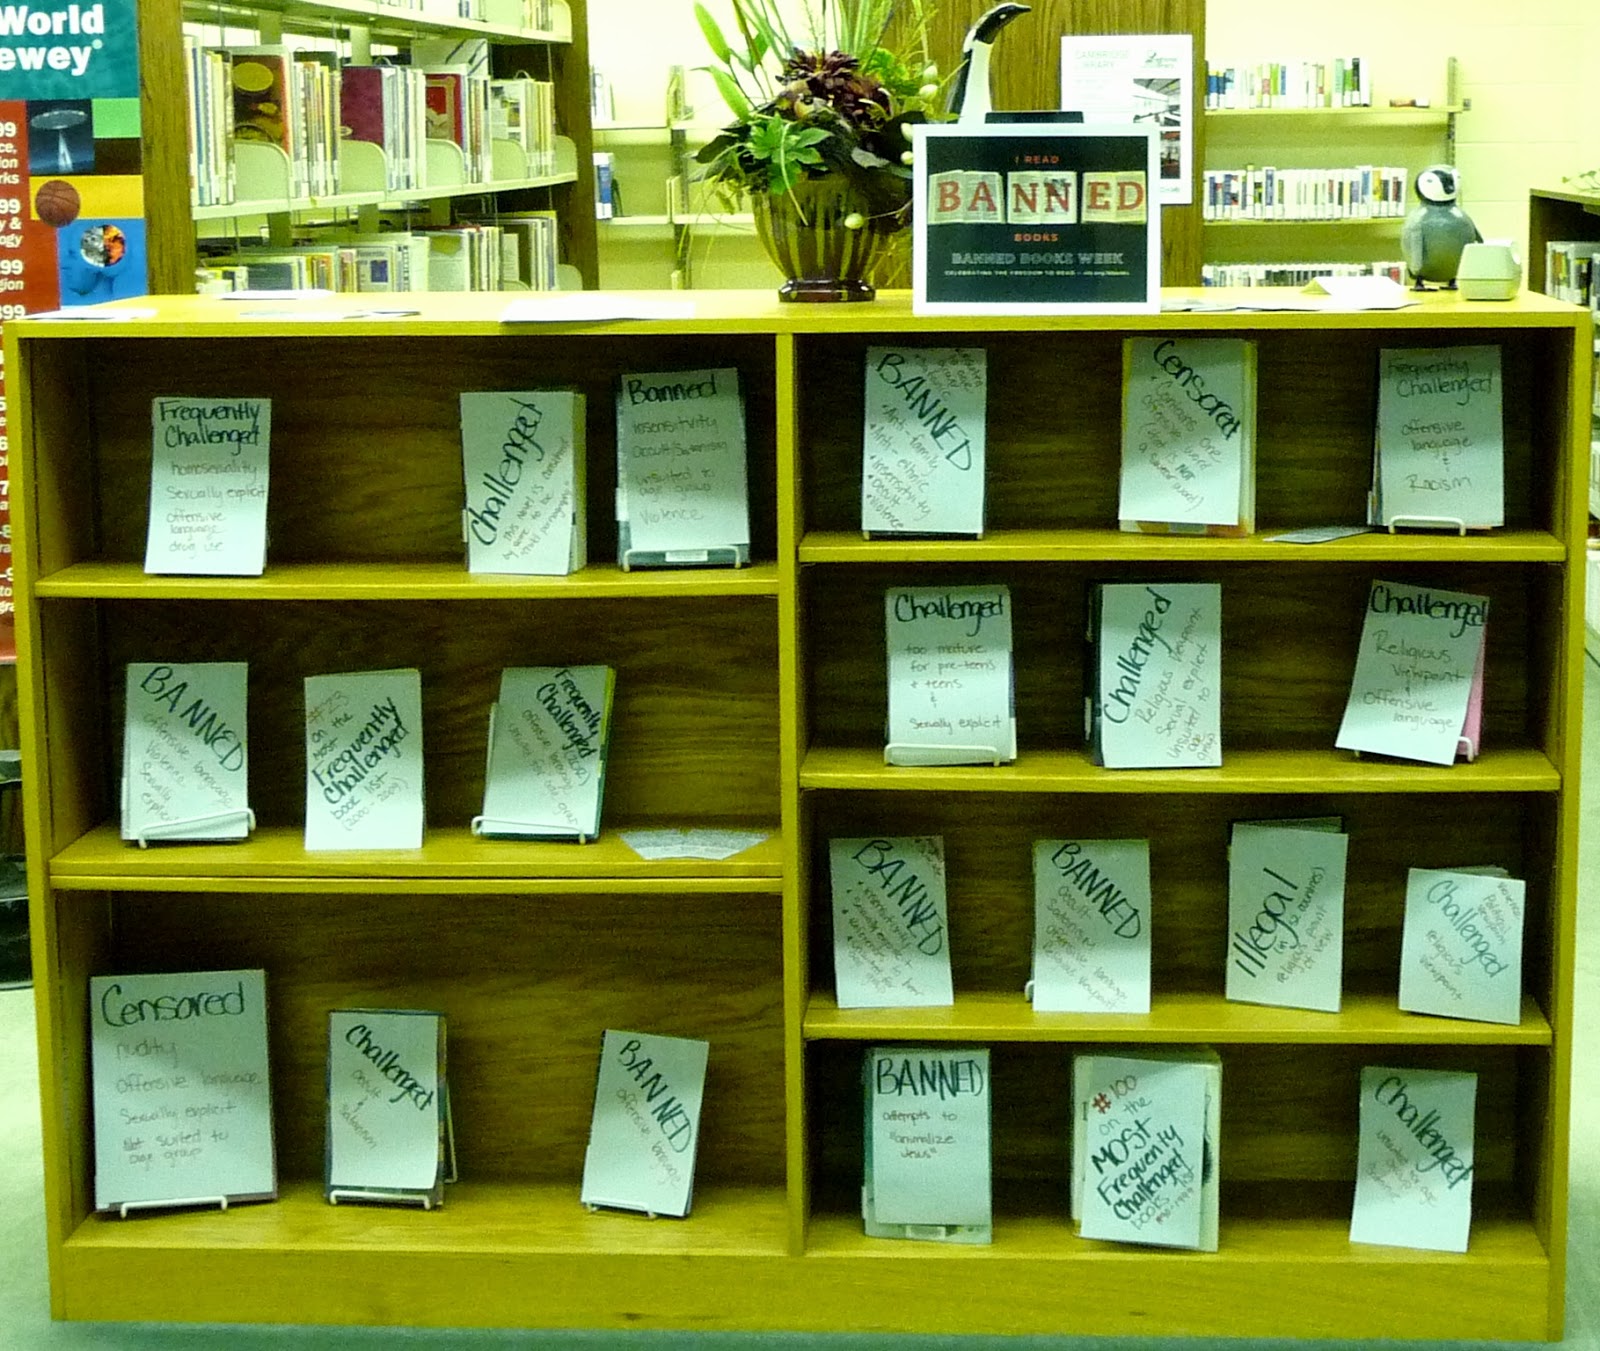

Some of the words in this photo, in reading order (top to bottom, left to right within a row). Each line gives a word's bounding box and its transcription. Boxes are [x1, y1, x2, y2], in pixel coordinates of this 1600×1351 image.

[0, 5, 104, 35] World
[1024, 156, 1060, 164] READ
[937, 180, 1146, 214] BANNED
[951, 253, 1016, 264] BANNED
[1020, 253, 1074, 264] BOOKS
[1078, 253, 1125, 264] WEEK
[1013, 233, 1059, 242] BOOKS
[627, 373, 718, 406] Banned
[1153, 340, 1241, 440] Censored
[1388, 357, 1470, 381] Frequently
[1396, 373, 1493, 406] Challenged
[159, 400, 261, 430] Frequently
[876, 353, 971, 471] BANNED
[165, 424, 260, 456] Challenged
[467, 397, 545, 546] Challenged
[1405, 473, 1472, 493] Racism
[895, 594, 1003, 637] Challenged
[1371, 585, 1486, 638] Challenged
[1103, 586, 1172, 724] Challenged
[1372, 629, 1452, 668] Religious
[140, 666, 244, 772] BANNED
[536, 682, 598, 759] Challenged
[554, 669, 602, 739] Frequently
[1393, 713, 1456, 733] language
[311, 696, 402, 787] Frequently
[323, 725, 411, 804] Challenged
[851, 839, 944, 956] BANNED
[1051, 842, 1141, 938] BANNED
[1427, 880, 1510, 978] Challenged
[101, 981, 244, 1027] Censored
[345, 1024, 434, 1111] Challenged
[877, 1057, 984, 1100] BANNED
[617, 1040, 692, 1153] BANNED
[942, 1112, 958, 1121] to
[1099, 1118, 1120, 1136] on
[1123, 1096, 1153, 1116] the
[211, 1129, 229, 1142] to
[1374, 1076, 1474, 1190] Challenged
[1113, 1148, 1193, 1221] Challenged
